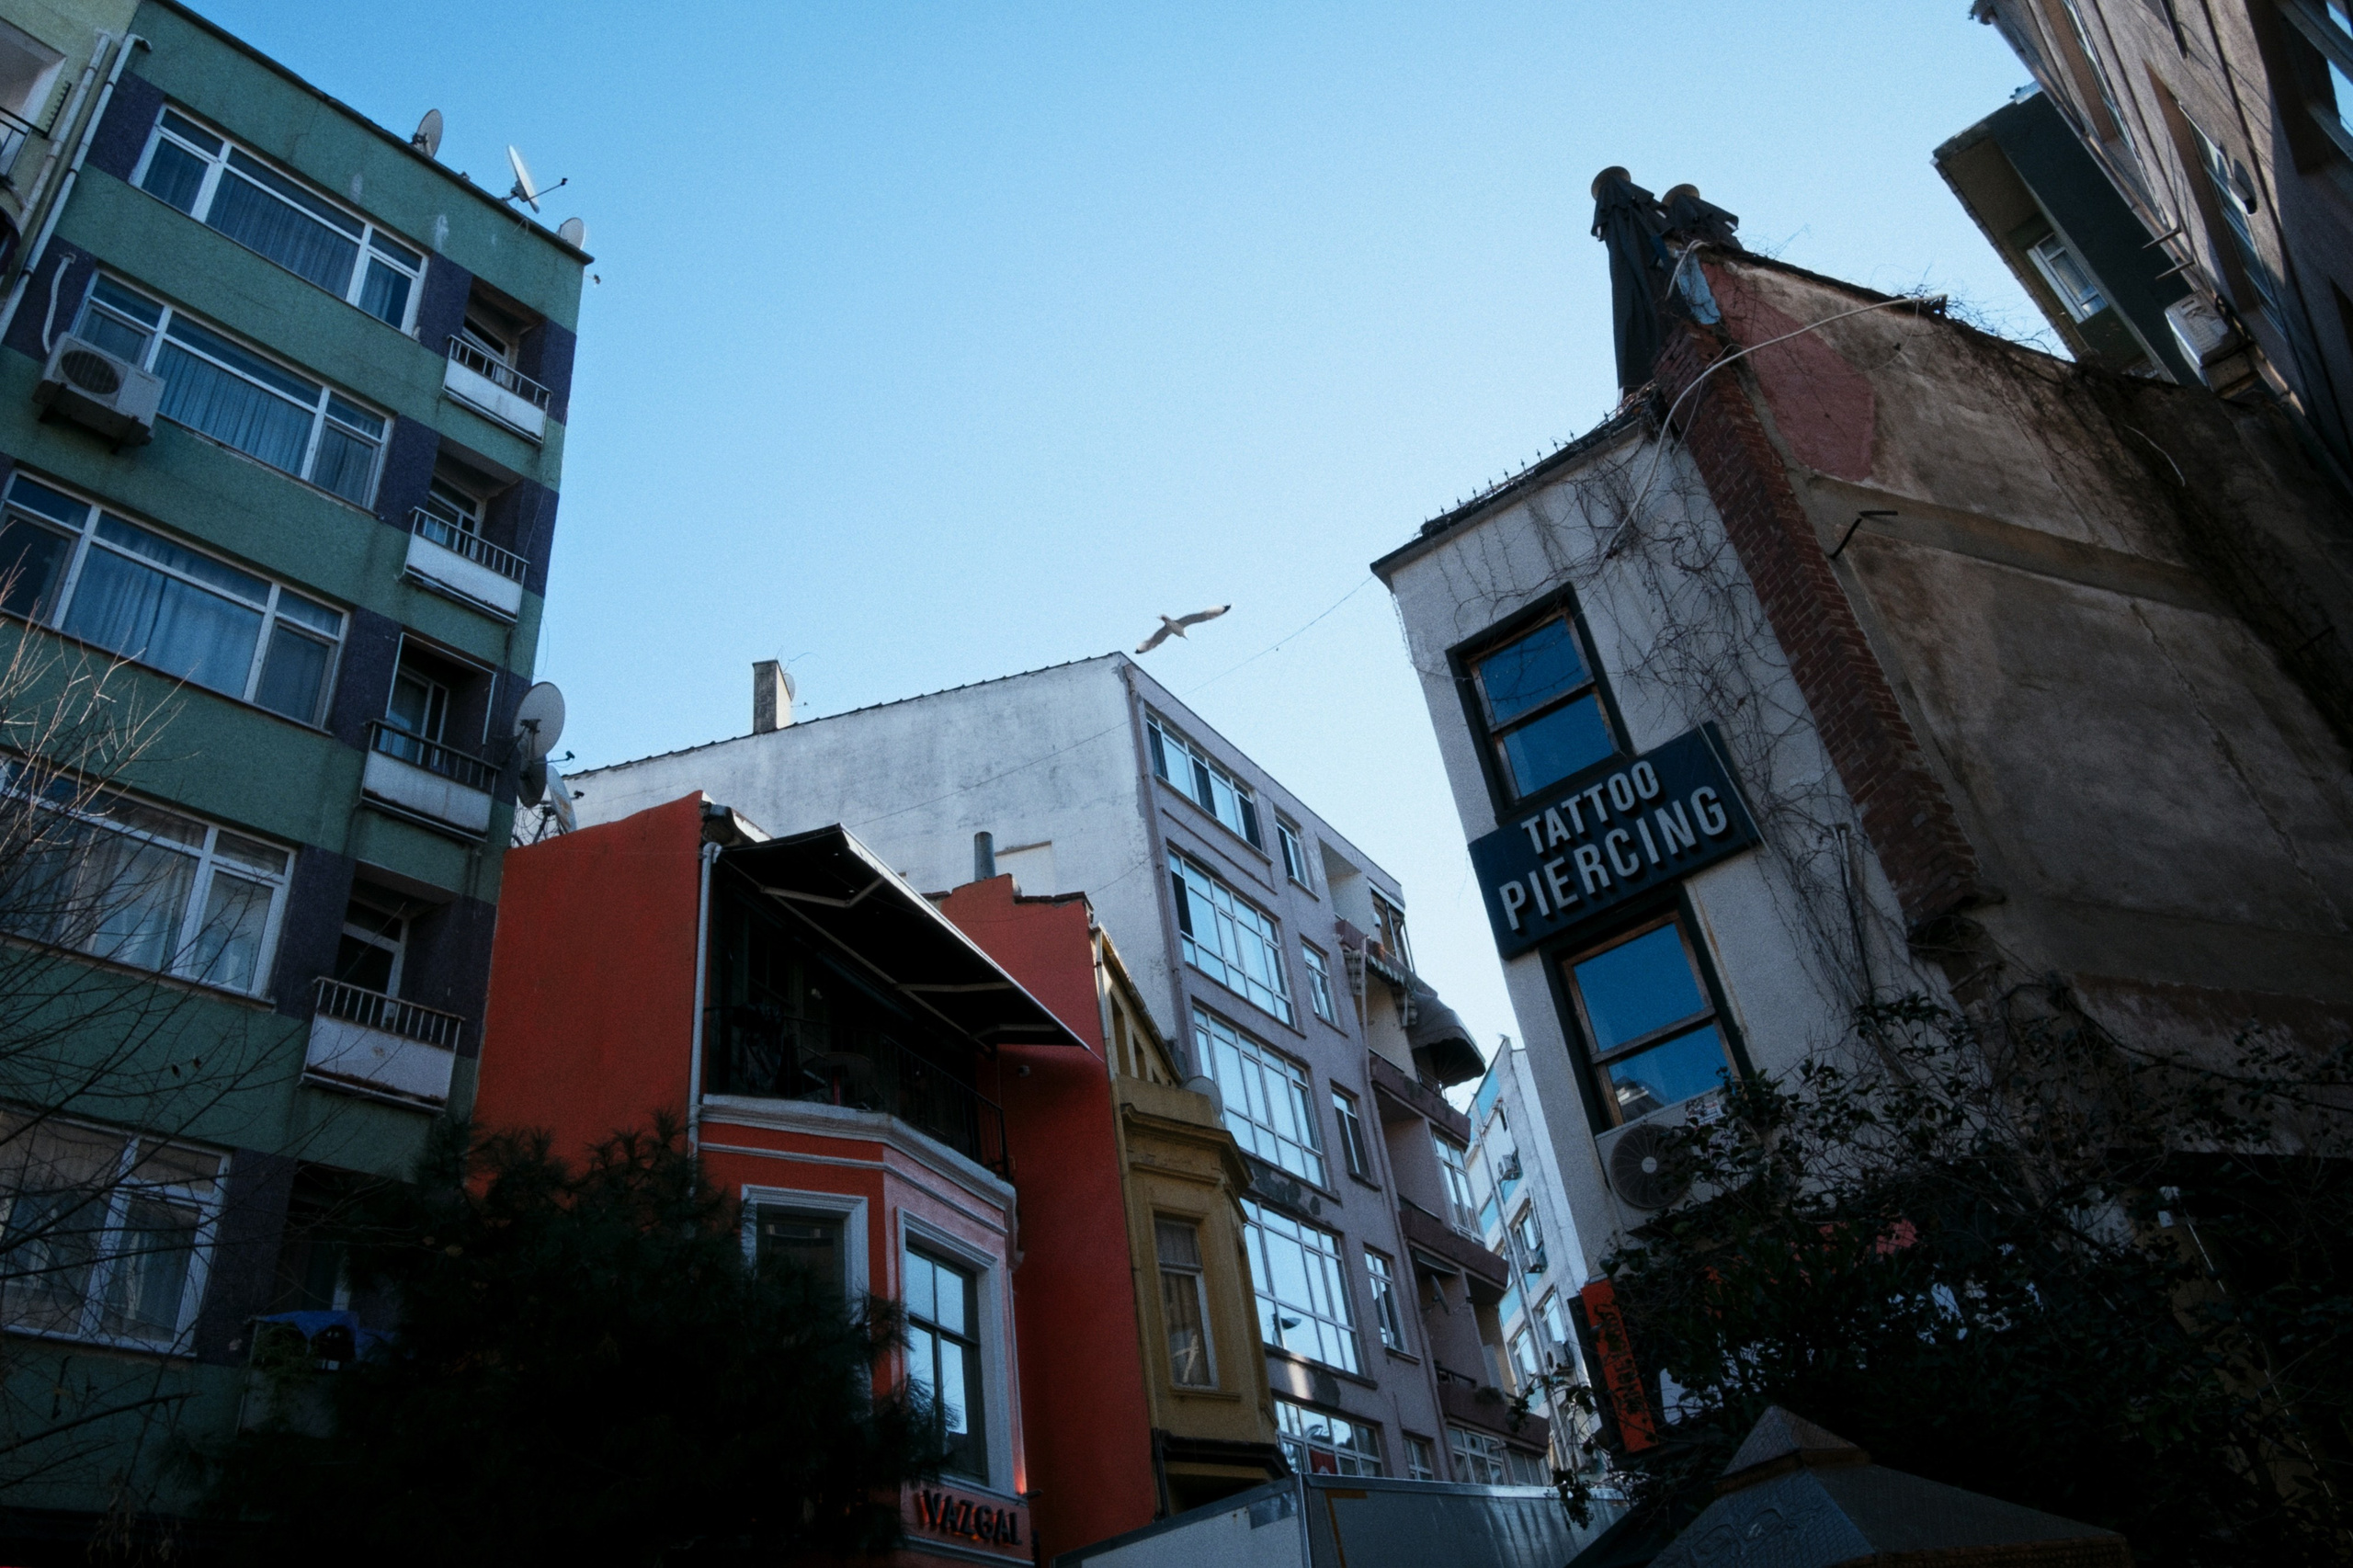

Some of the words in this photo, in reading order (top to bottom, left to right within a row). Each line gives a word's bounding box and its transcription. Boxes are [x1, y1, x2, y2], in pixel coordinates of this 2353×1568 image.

[1520, 759, 1661, 856] TATTOO
[1498, 785, 1728, 932] PIERCING
[923, 1489, 1023, 1546] VAZGAL
